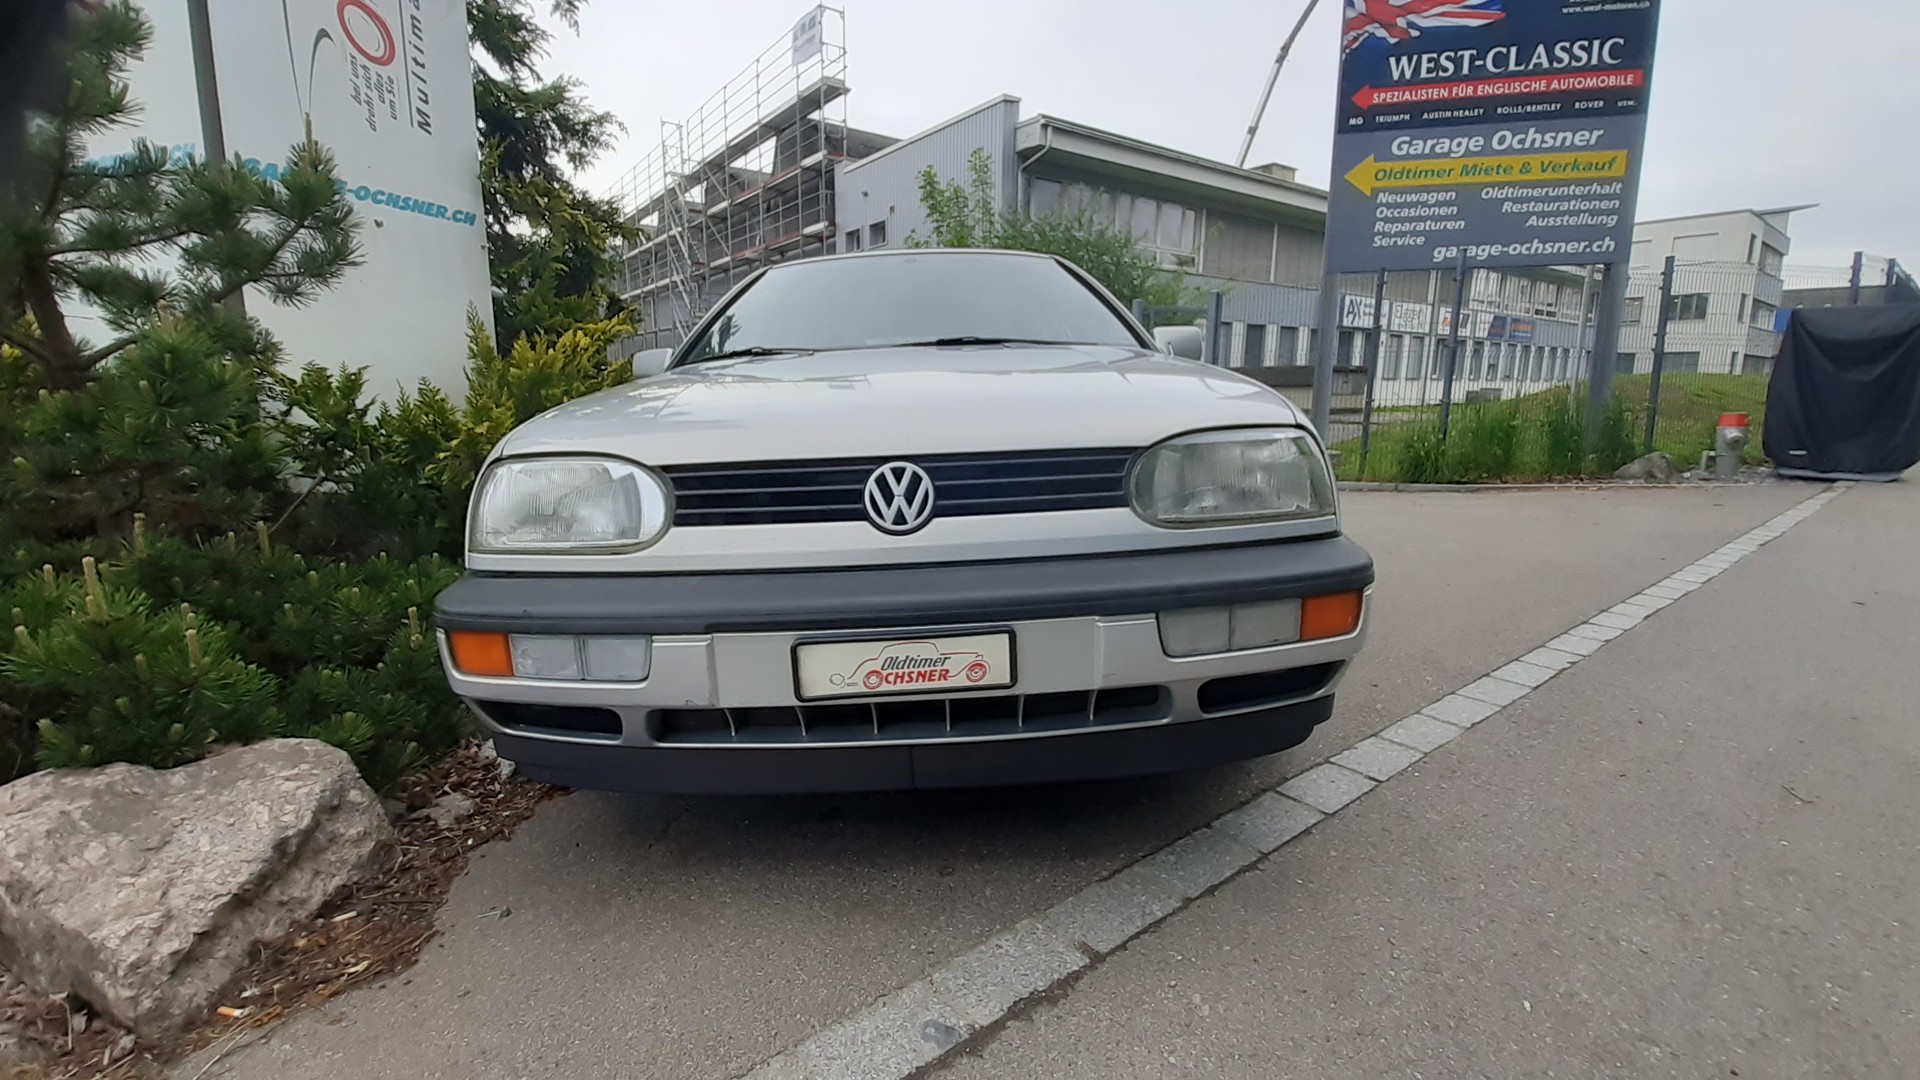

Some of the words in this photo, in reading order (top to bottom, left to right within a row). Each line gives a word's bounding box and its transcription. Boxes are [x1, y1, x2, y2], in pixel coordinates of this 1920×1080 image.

[349, 52, 360, 79] uns
[1388, 37, 1625, 81] WEST-CLASSIC
[360, 63, 373, 93] sich
[373, 71, 386, 104] alles
[385, 75, 396, 98] Sie
[1372, 88, 1449, 104] SPEZIALISTEN
[1452, 83, 1473, 98] FÜR
[1477, 79, 1547, 95] ENGLISCHE
[1549, 74, 1635, 91] AUTOMOBILE
[349, 79, 362, 106] bei
[363, 92, 378, 132] dreht
[388, 99, 397, 121] um
[1349, 116, 1364, 126] MG
[1375, 113, 1411, 124] TRIUMPH
[1422, 110, 1452, 120] AUSTIN
[1453, 108, 1485, 118] HEALEY
[1496, 103, 1562, 114] ROLLS/BENTLEY
[1574, 100, 1605, 109] ROVER
[1391, 135, 1485, 158] Garage
[1491, 127, 1605, 151] Ochsner
[1374, 166, 1455, 181] Oldtimer
[1459, 162, 1514, 177] Miete
[1519, 161, 1532, 174] &
[1540, 155, 1618, 173] Verkauf
[1376, 191, 1456, 204] Neuwagen
[1481, 182, 1623, 199] Oldtimerunterhalt
[1375, 205, 1458, 218] Occasionen
[1501, 198, 1620, 213] Restaurationen
[1373, 220, 1465, 234] Reparaturen
[1525, 213, 1619, 227] Ausstellung
[1372, 234, 1426, 247] Service
[864, 461, 934, 531] VW
[880, 654, 951, 671] Oldtimer
